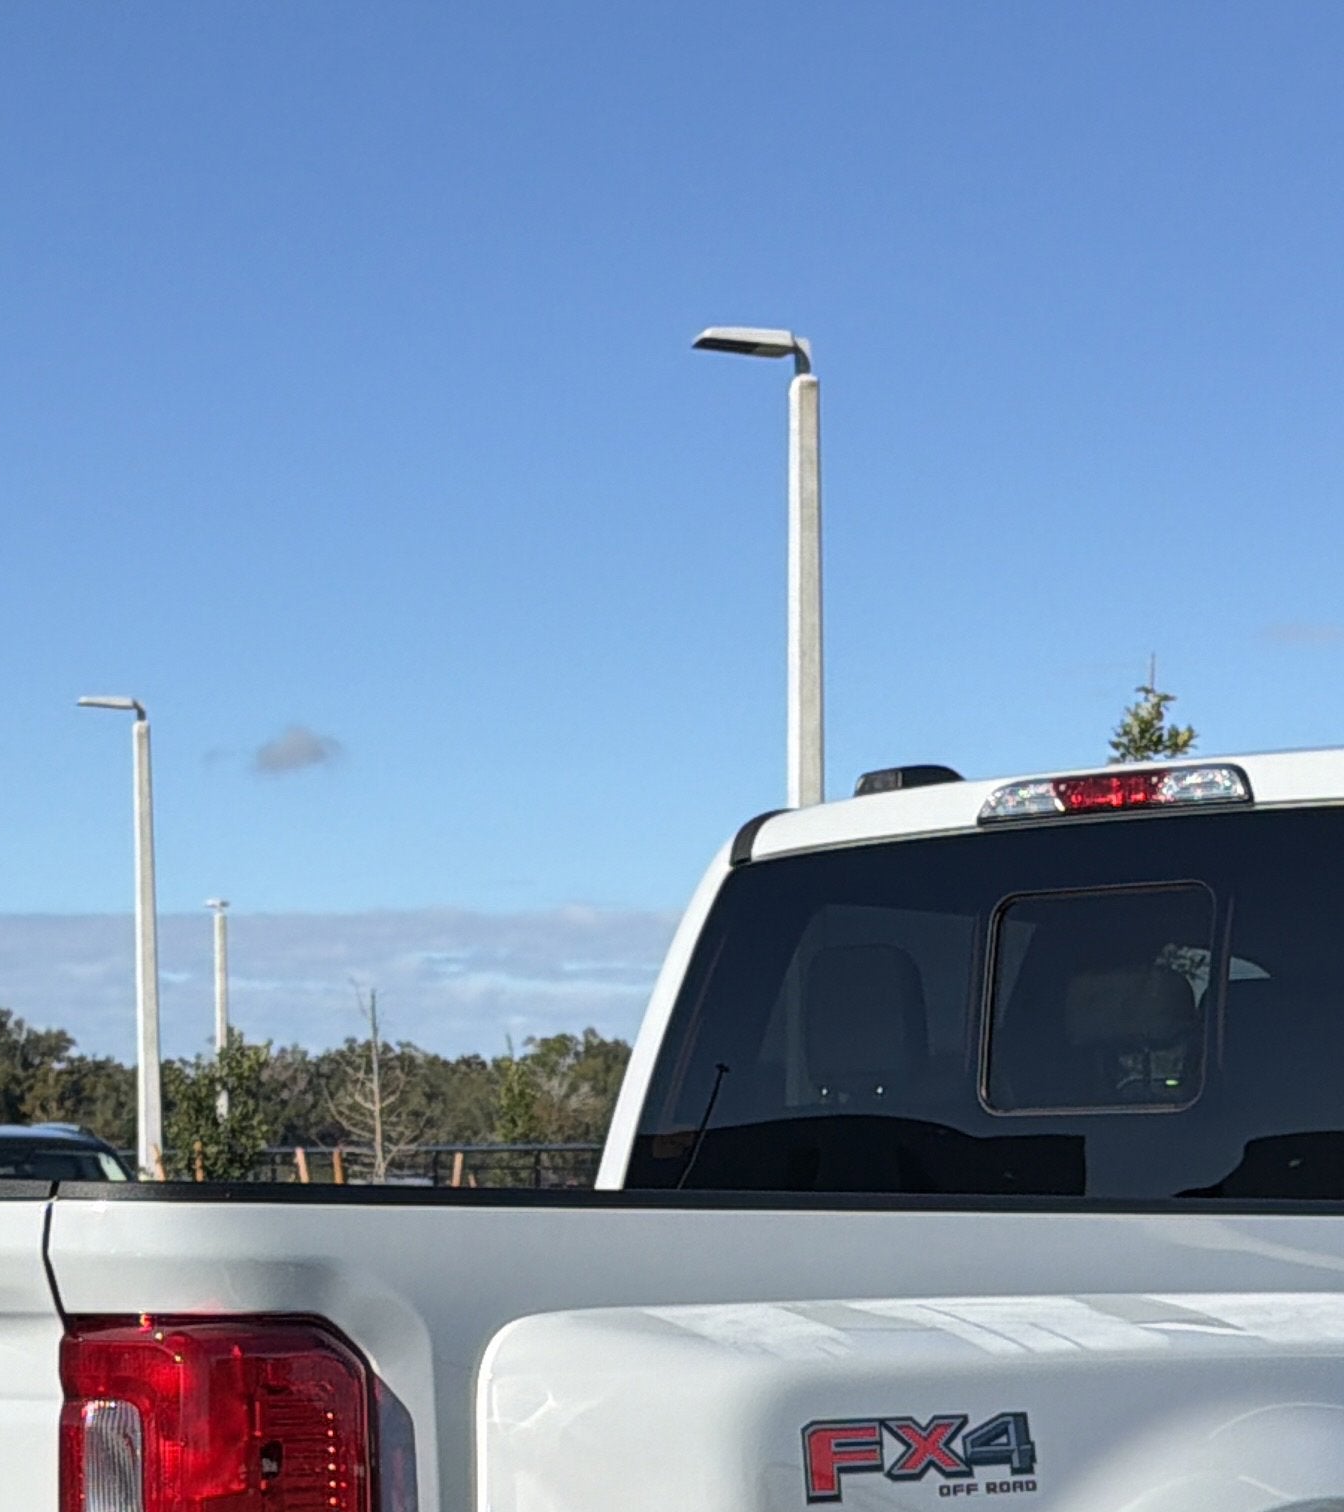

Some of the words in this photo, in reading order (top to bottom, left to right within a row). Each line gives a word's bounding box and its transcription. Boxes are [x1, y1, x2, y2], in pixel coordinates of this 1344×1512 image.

[801, 1411, 1037, 1505] FX4
[938, 1483, 979, 1498] OFF
[985, 1479, 1038, 1495] ROAD
